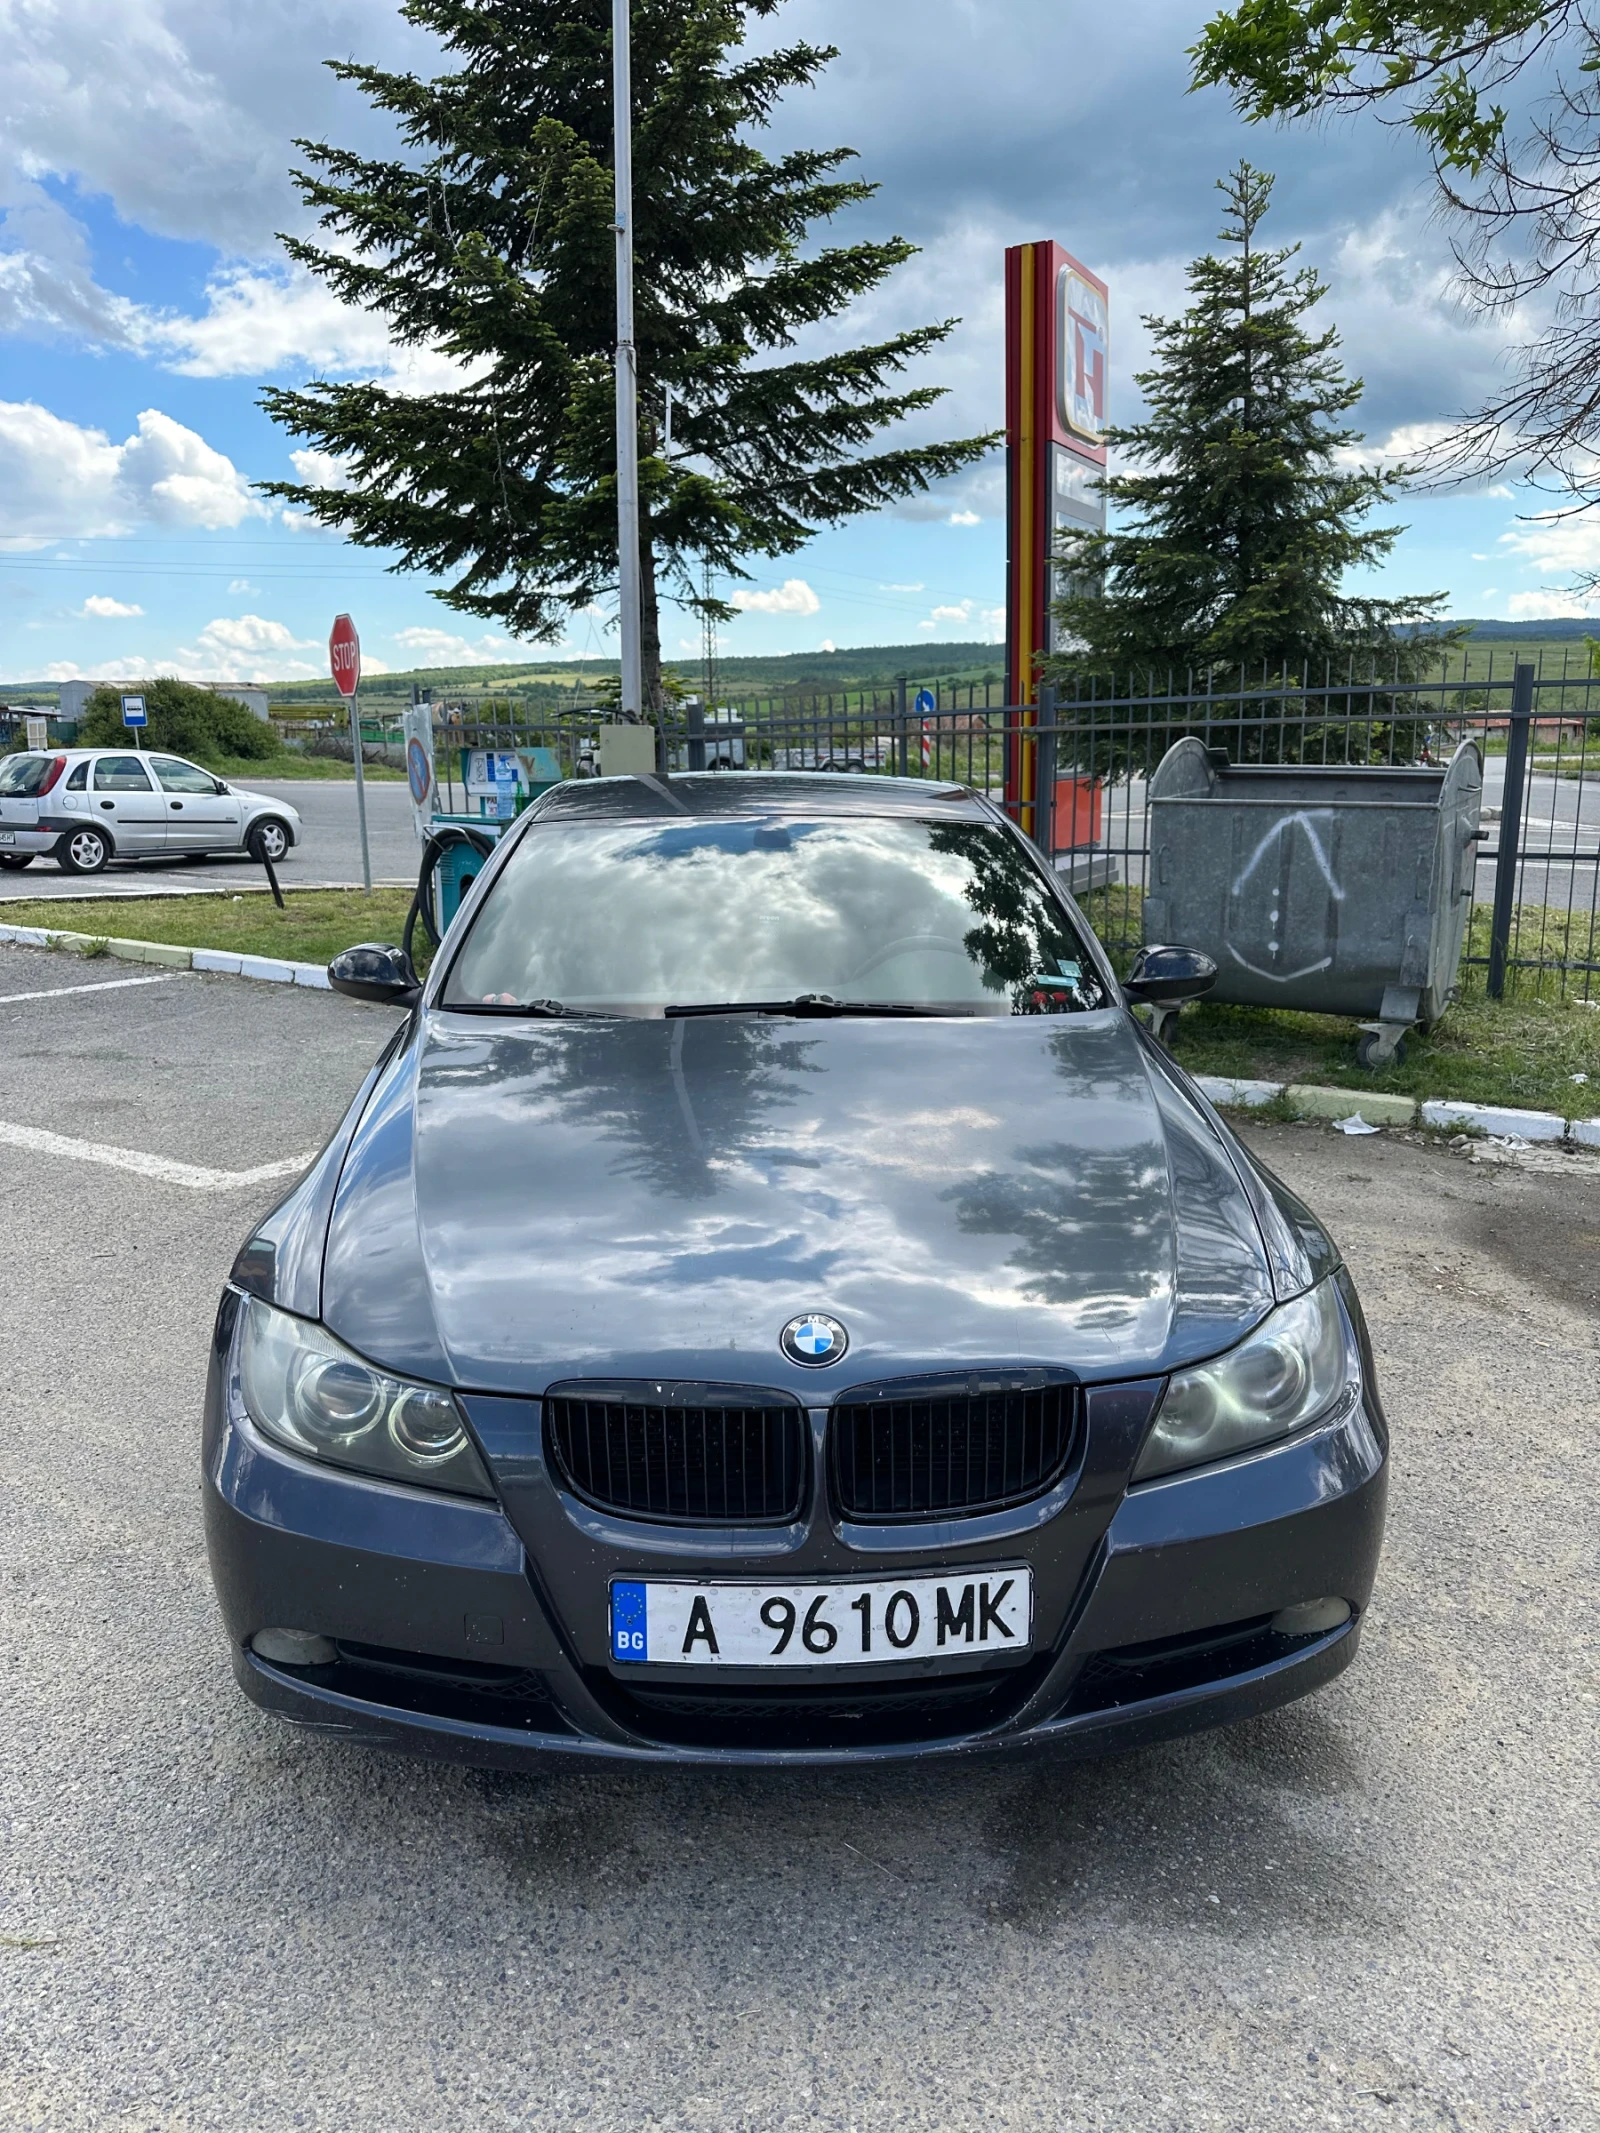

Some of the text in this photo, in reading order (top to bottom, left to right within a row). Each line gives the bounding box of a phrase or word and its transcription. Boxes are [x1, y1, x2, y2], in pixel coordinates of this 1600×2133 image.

[333, 641, 356, 671] STOP
[788, 1315, 840, 1331] BMW
[682, 1579, 1016, 1655] A 9610 MK
[617, 1631, 644, 1650] BG
